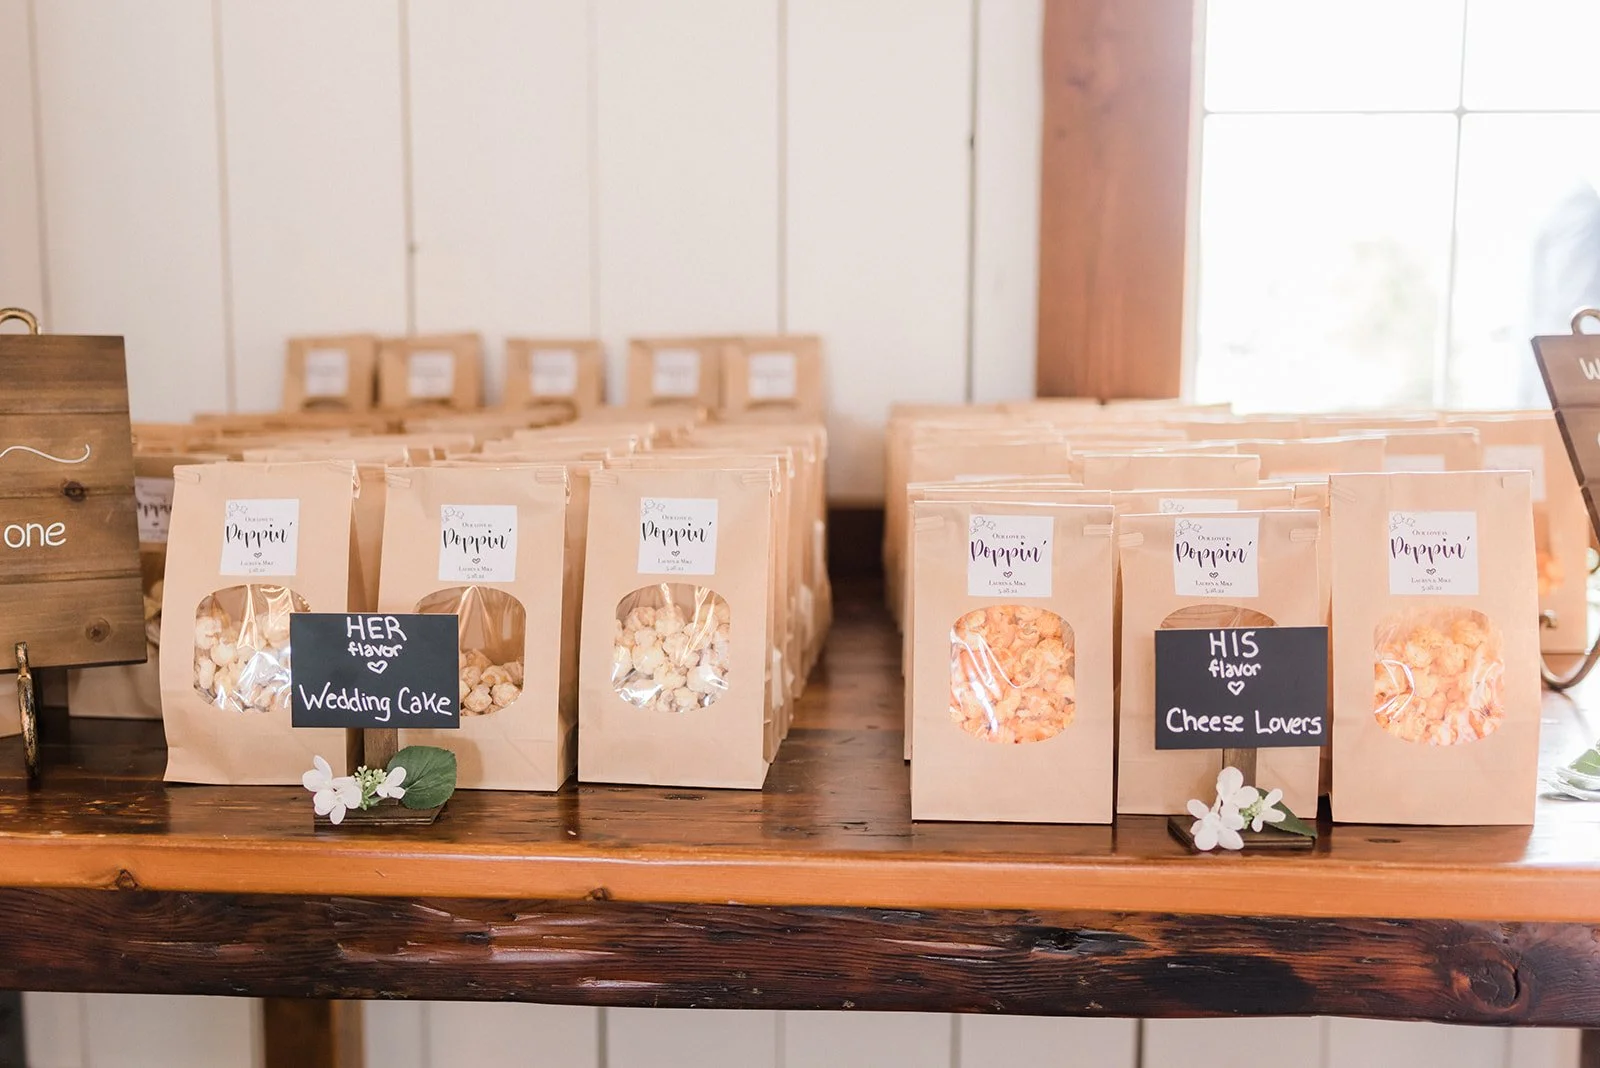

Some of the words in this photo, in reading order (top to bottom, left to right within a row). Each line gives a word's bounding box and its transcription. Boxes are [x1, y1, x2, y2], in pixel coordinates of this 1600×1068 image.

[4, 522, 67, 548] one
[227, 522, 292, 548] Poppin'
[443, 528, 511, 554] Poppin'
[642, 520, 712, 546] Poppin'
[971, 539, 1046, 567] Poppin'
[1176, 541, 1252, 568] Poppin'
[1391, 536, 1470, 564] Poppin'
[346, 615, 407, 641] HER
[347, 641, 403, 658] flavor
[1209, 630, 1260, 658] HIS
[1208, 658, 1262, 678] flavor
[299, 681, 391, 722] Wedding
[397, 686, 453, 716] Cake
[1166, 707, 1244, 733] Cheese
[1254, 709, 1323, 735] Lovers
